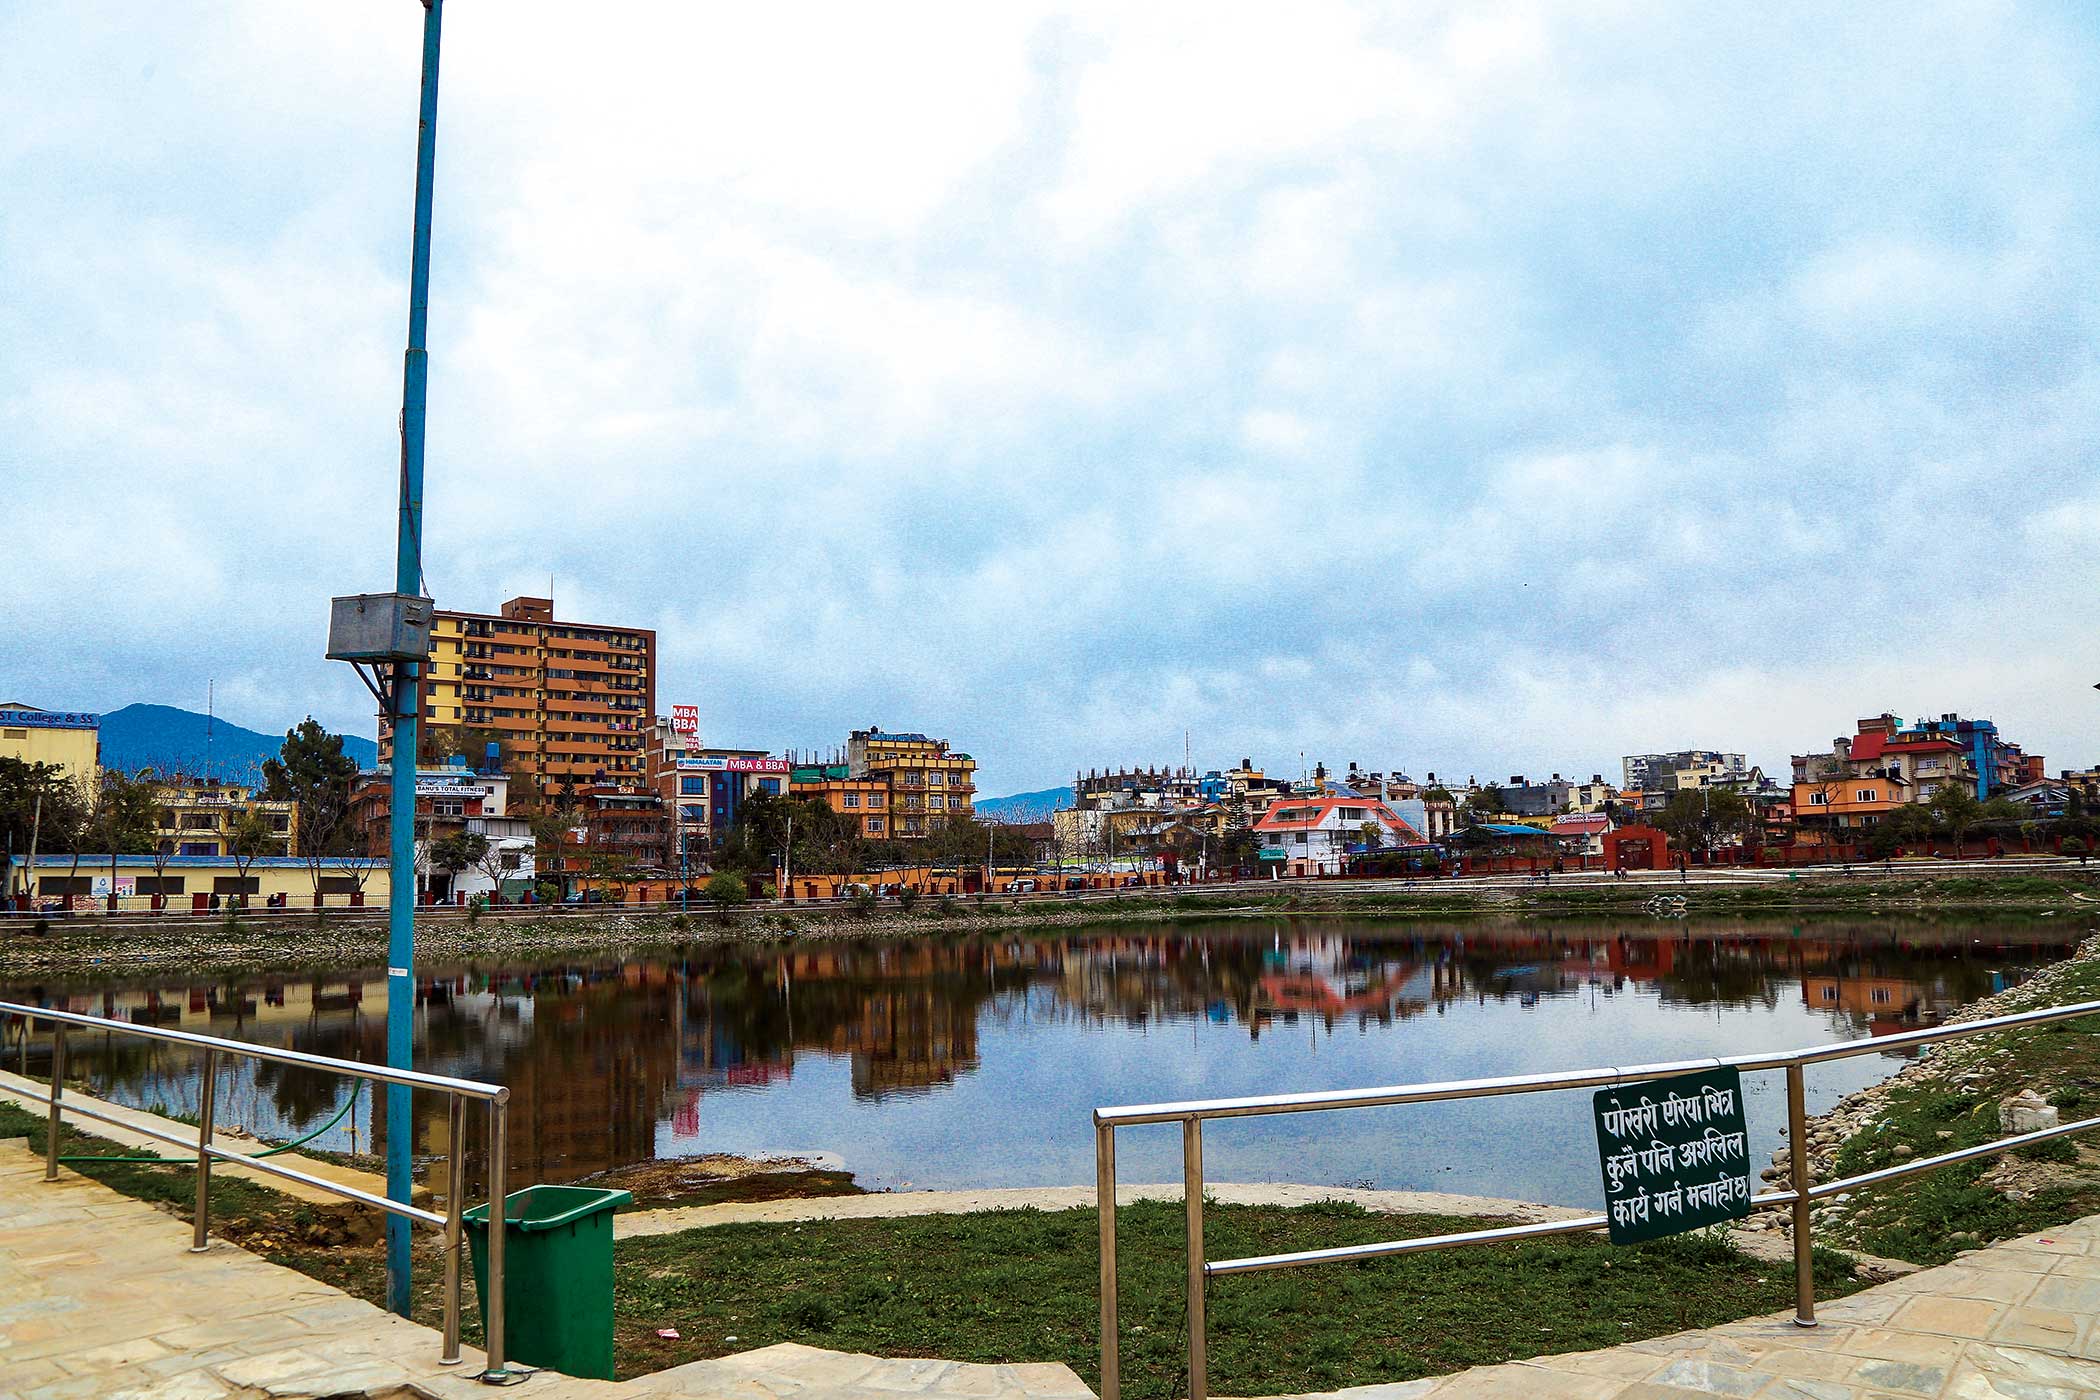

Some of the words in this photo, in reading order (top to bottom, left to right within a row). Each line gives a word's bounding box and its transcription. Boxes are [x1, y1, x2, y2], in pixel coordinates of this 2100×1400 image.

[18, 711, 61, 723] College
[65, 714, 75, 723] &
[80, 714, 93, 723] SS
[673, 708, 697, 718] MBA
[673, 718, 697, 730] BBA
[730, 760, 753, 769] MBA
[755, 760, 763, 769] &
[765, 761, 785, 770] BBA
[1601, 1095, 1659, 1141] पोखरी
[1659, 1091, 1702, 1128] एरिया
[1701, 1085, 1735, 1120] भित्र
[1606, 1144, 1639, 1193] कुनै
[1638, 1139, 1676, 1175] पनि
[1612, 1186, 1650, 1228] कार्य
[1653, 1180, 1684, 1217] गर्न
[1686, 1171, 1734, 1212] मनाही
